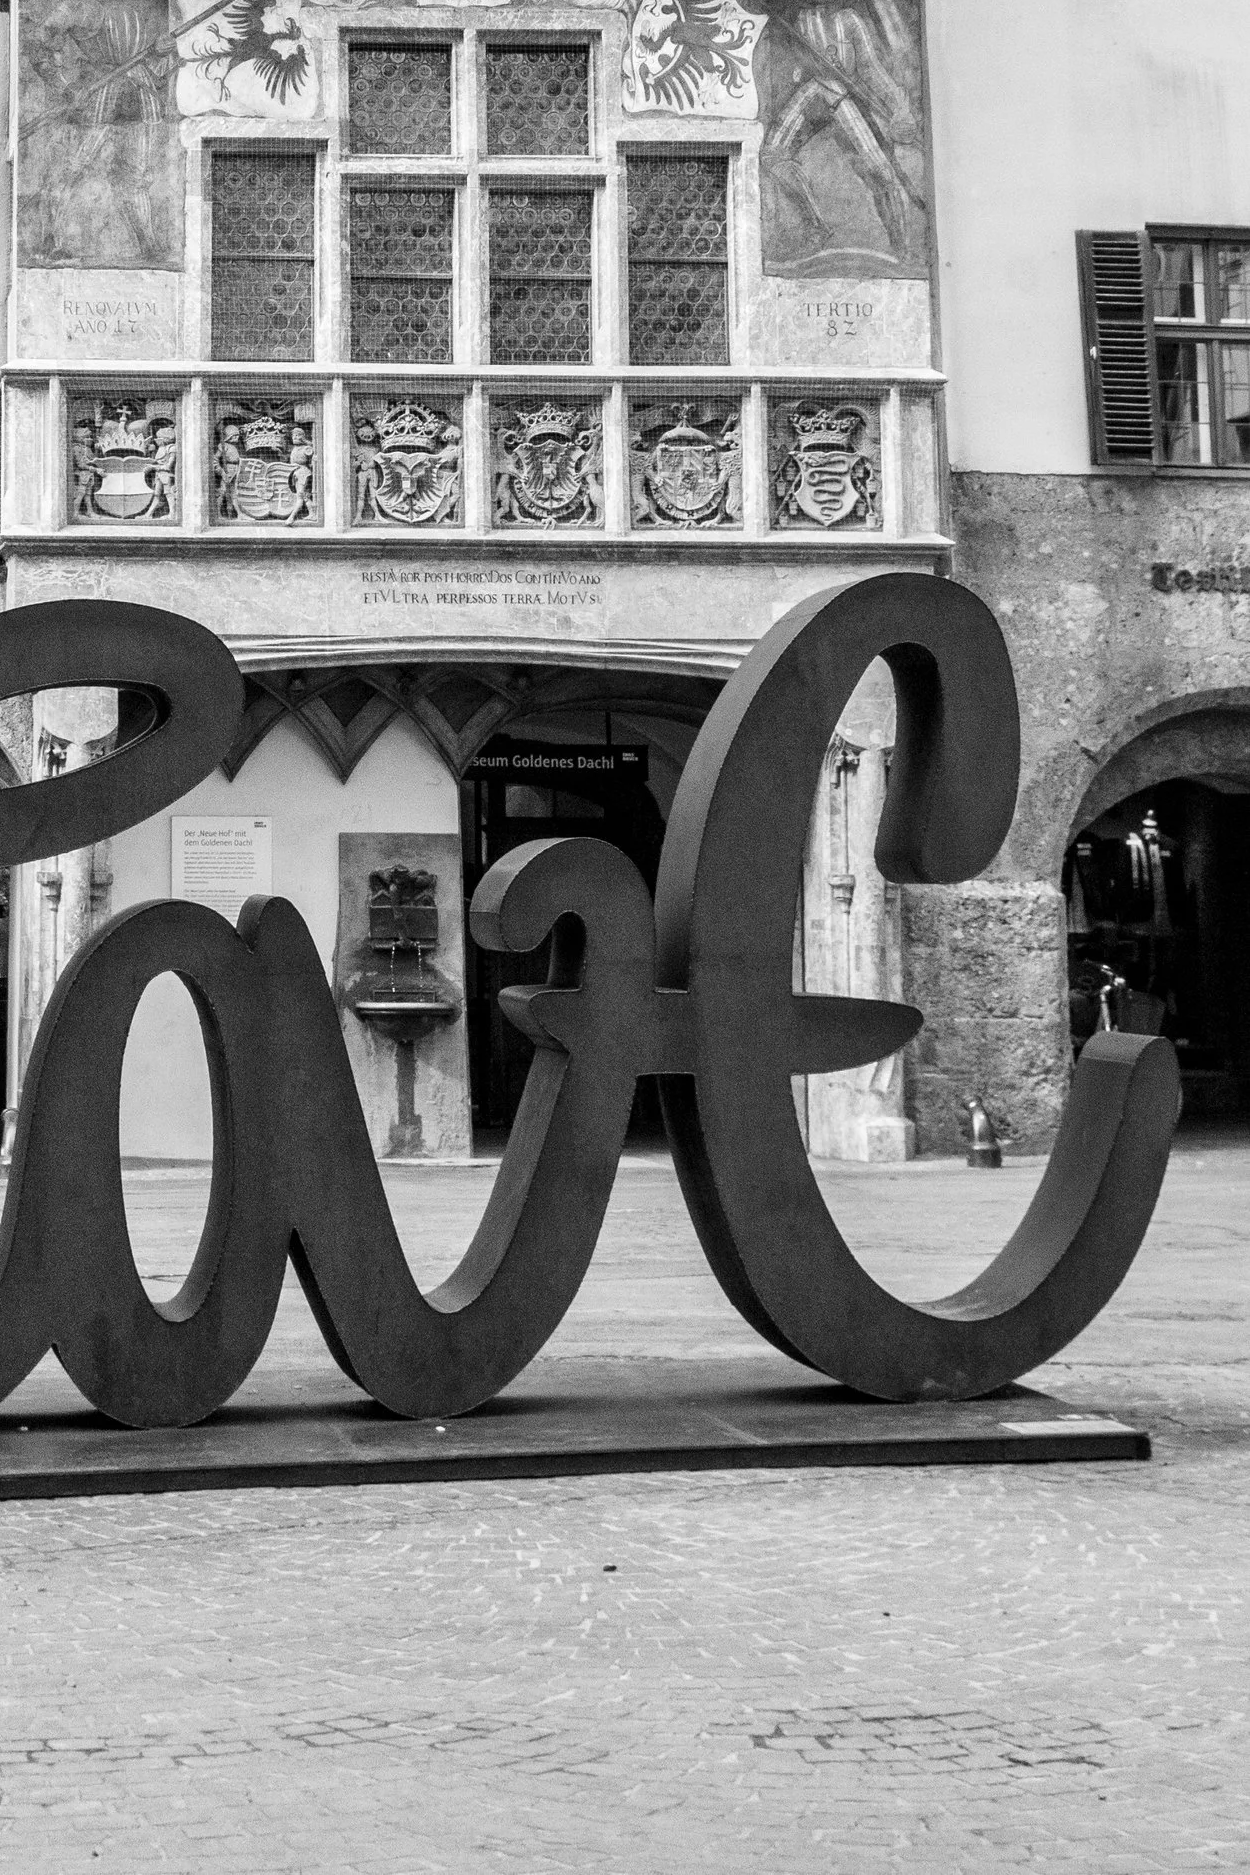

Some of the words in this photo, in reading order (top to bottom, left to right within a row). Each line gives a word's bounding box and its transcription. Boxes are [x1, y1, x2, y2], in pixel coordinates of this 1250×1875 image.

[803, 302, 873, 317] TERTIO
[470, 756, 508, 767] seum
[512, 754, 574, 769] Goldenes
[578, 756, 614, 769] Dachl
[183, 829, 196, 837] Der
[184, 838, 199, 846] dem
[201, 838, 232, 847] Goldenen
